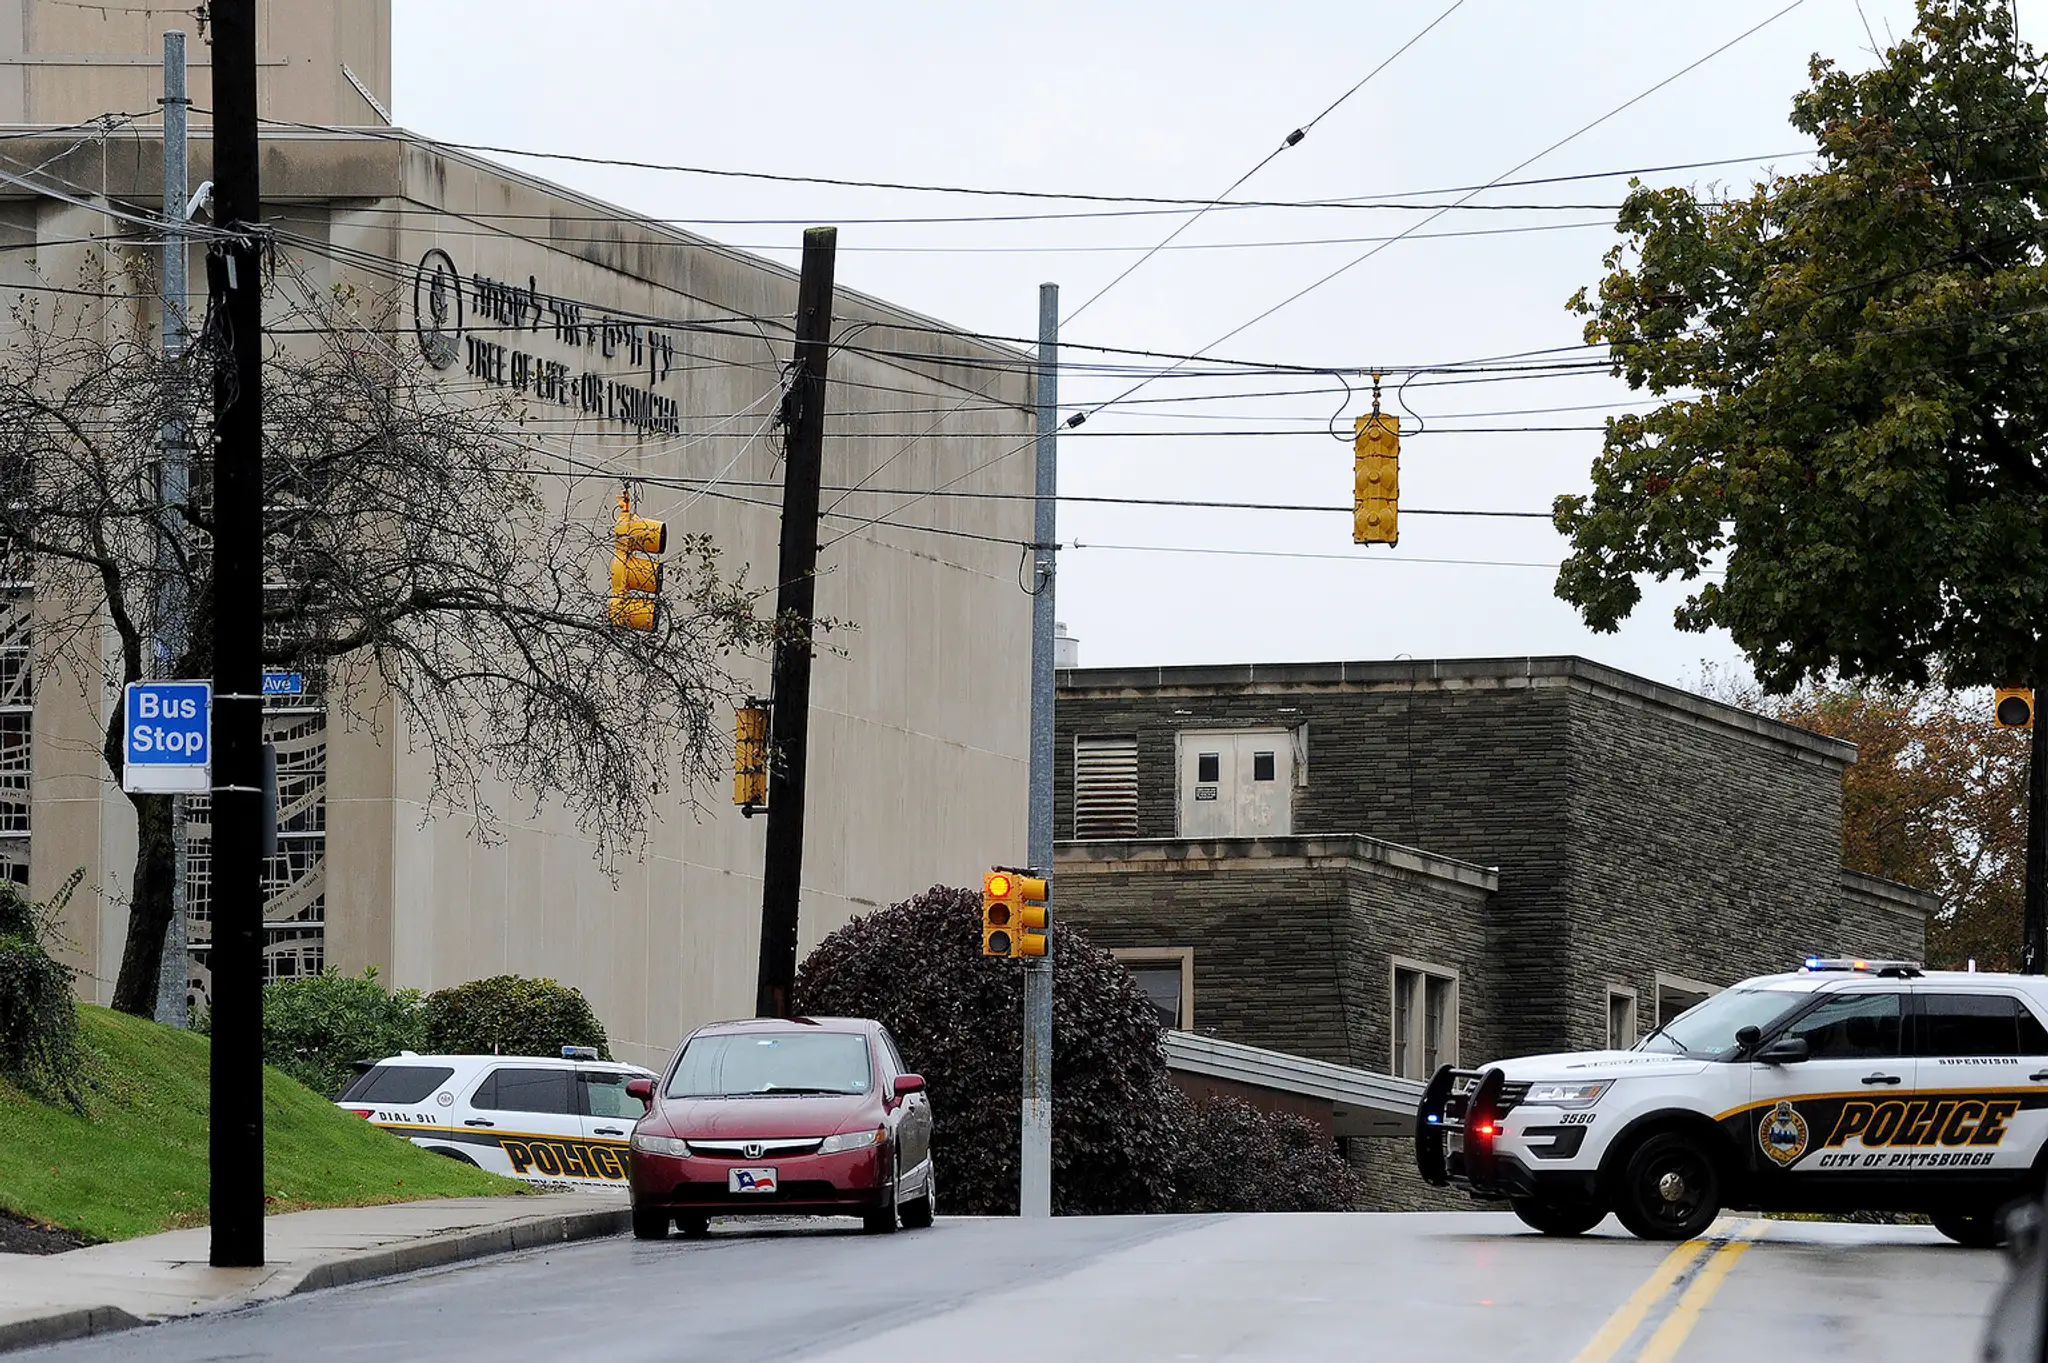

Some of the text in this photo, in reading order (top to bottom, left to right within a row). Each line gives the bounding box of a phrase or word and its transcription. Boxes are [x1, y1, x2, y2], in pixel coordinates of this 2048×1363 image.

[465, 334, 507, 387] TREE
[510, 350, 534, 392] OF
[536, 358, 571, 405] LIFE
[581, 372, 605, 414] OR
[262, 676, 292, 691] Ave
[139, 693, 196, 719] Bus
[132, 725, 204, 756] Stop
[1938, 1057, 2020, 1065] SUPERVISOR
[379, 1111, 437, 1124] DIAL 911
[1559, 1113, 1597, 1124] 3580
[1823, 1101, 2022, 1148] POLICE
[1819, 1152, 1995, 1167] CITY OF PITTSBURGH
